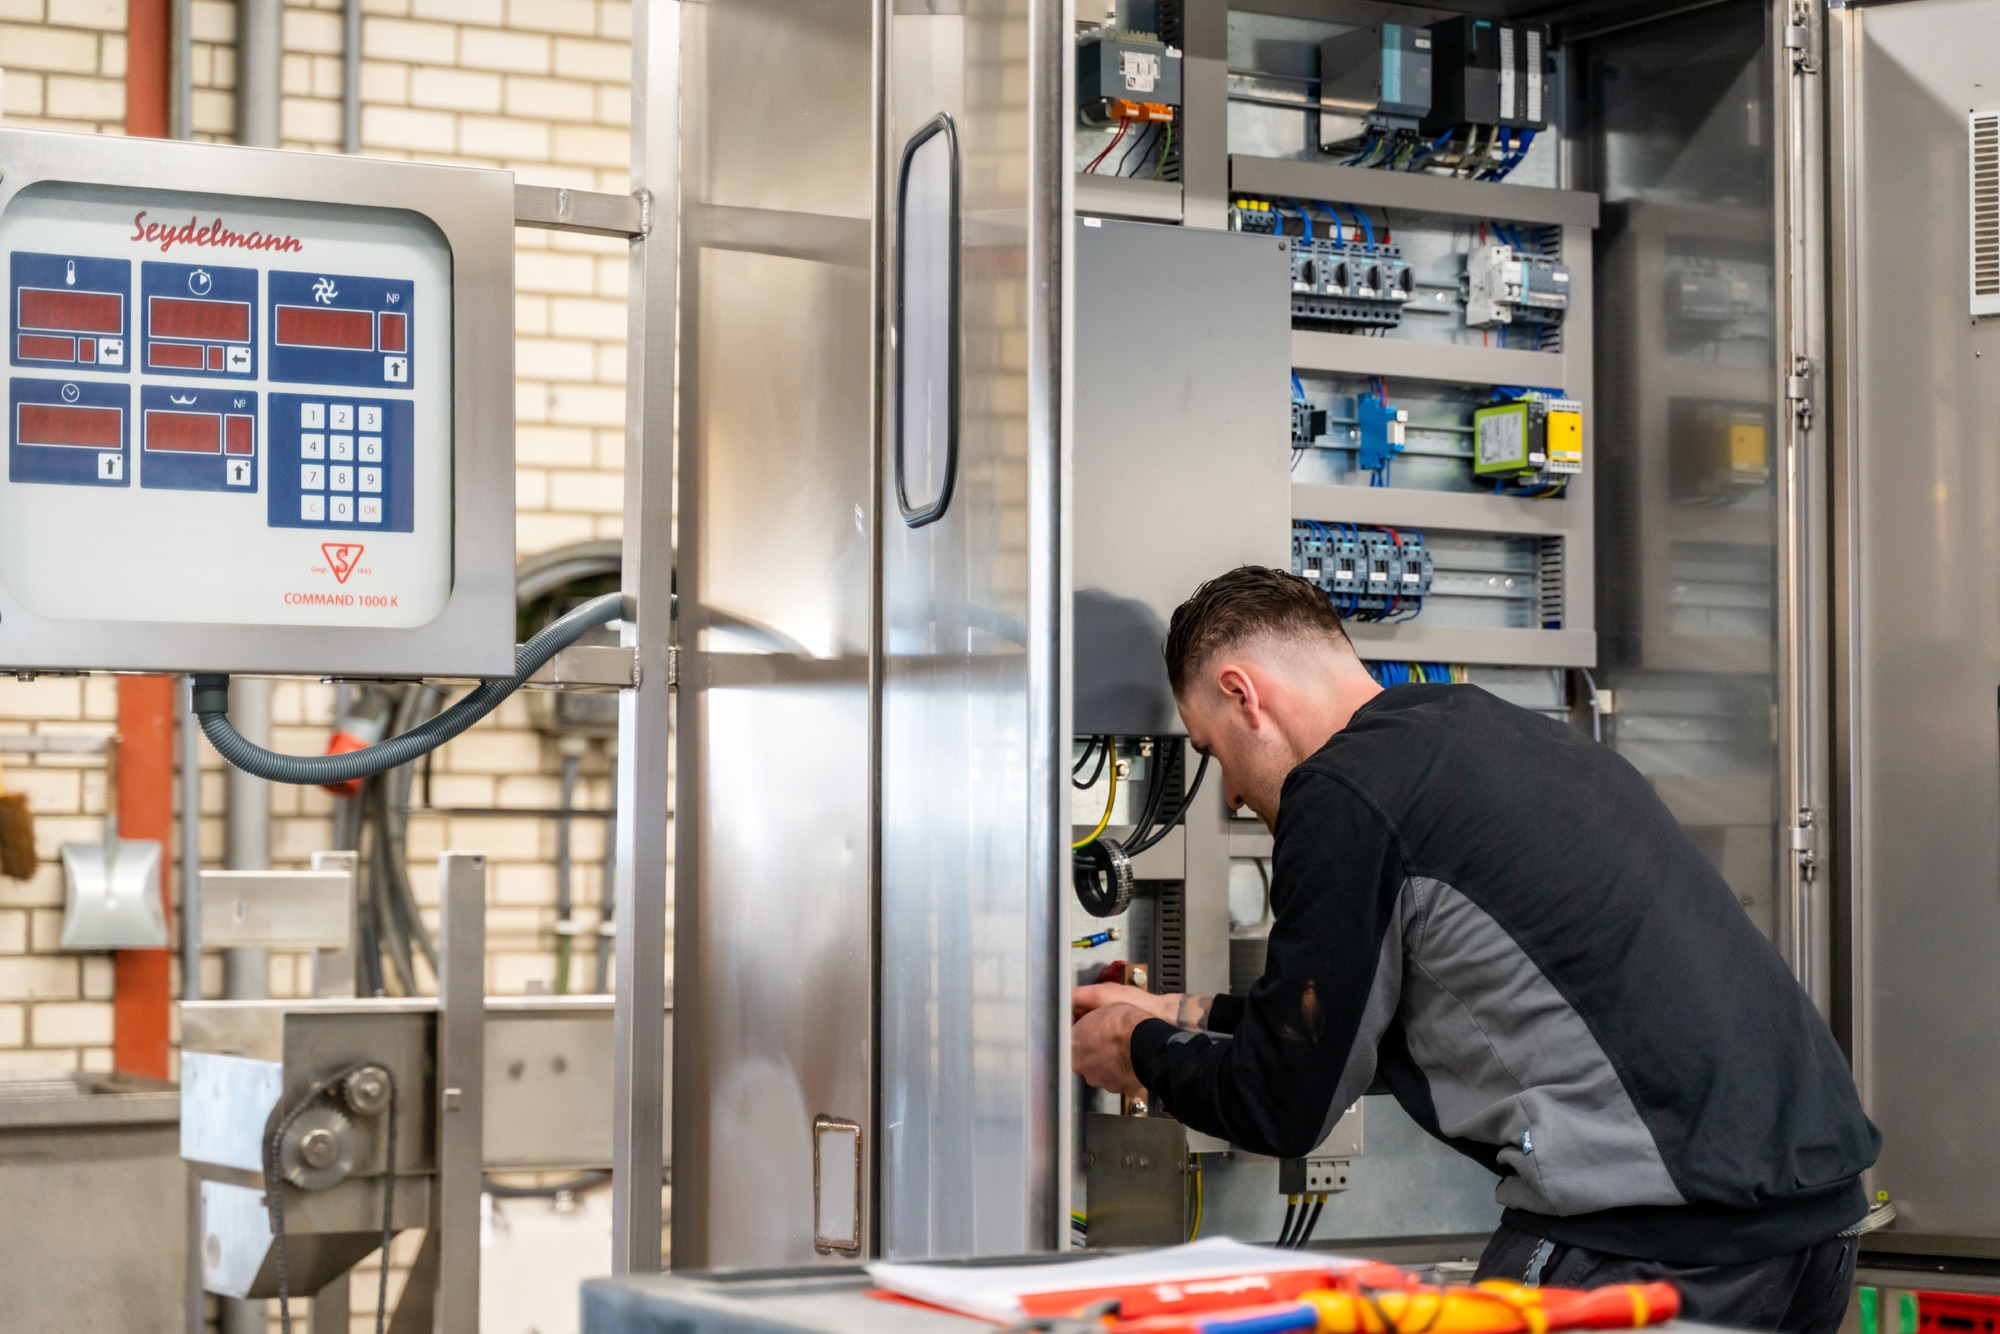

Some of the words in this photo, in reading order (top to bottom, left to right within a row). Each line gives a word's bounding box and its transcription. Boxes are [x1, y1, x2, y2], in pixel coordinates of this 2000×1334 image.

[130, 210, 302, 253] Seydelmann
[311, 410, 315, 421] 1
[338, 412, 346, 423] 2
[367, 413, 374, 425] 3
[309, 441, 317, 452] 4
[339, 442, 346, 454] 5
[366, 444, 375, 455] 6
[310, 471, 317, 482] 7
[338, 472, 346, 484] 8
[367, 474, 375, 485] 9
[309, 503, 316, 512] C
[338, 503, 346, 514] 0
[363, 505, 377, 514] OK
[284, 592, 354, 606] COMMAND
[358, 595, 388, 607] 1000
[390, 596, 399, 607] K
